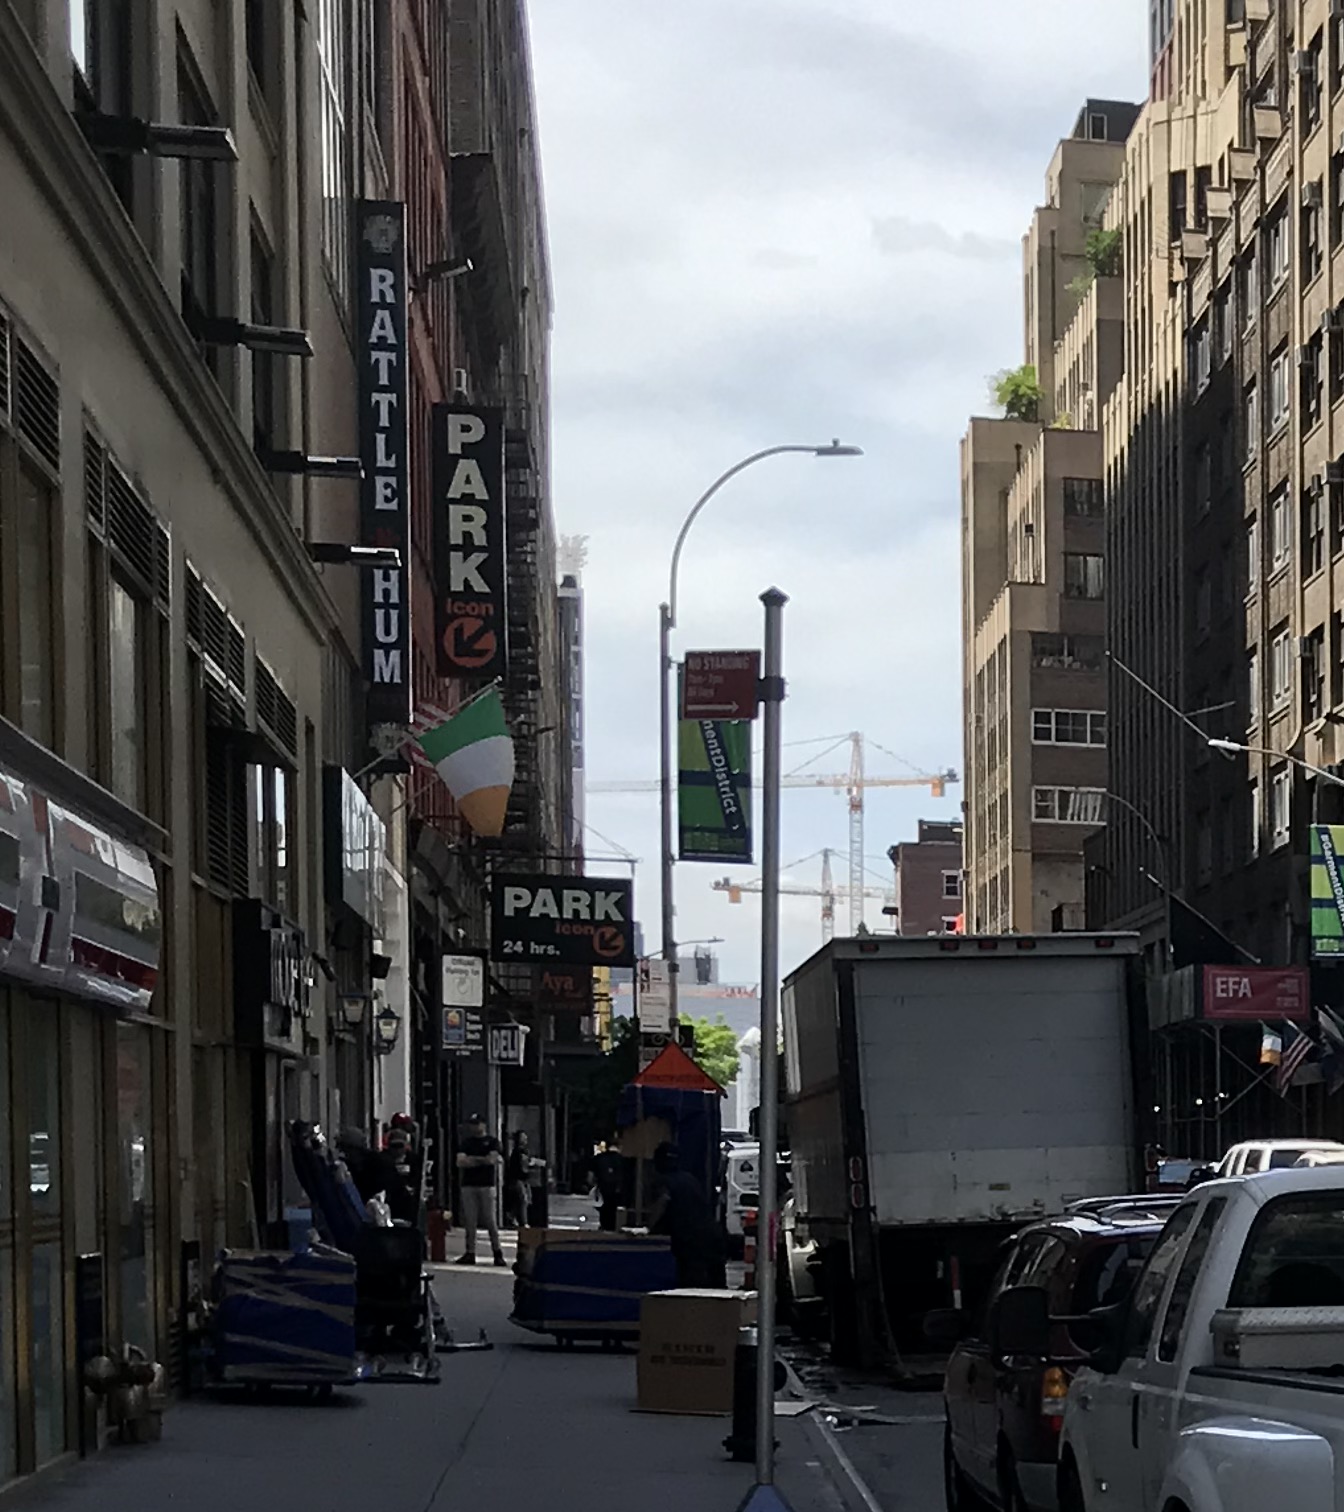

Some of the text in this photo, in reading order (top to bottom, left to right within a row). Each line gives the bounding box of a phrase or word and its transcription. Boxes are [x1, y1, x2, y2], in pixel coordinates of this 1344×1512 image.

[368, 267, 398, 512] RATTLE
[446, 413, 491, 594] PARK
[446, 598, 493, 616] icon
[374, 569, 402, 684] HUM
[503, 886, 625, 921] PARK
[555, 920, 595, 935] icon
[503, 940, 561, 956] 24 hrs.
[1215, 976, 1252, 998] EFA
[491, 1028, 519, 1059] DELI
